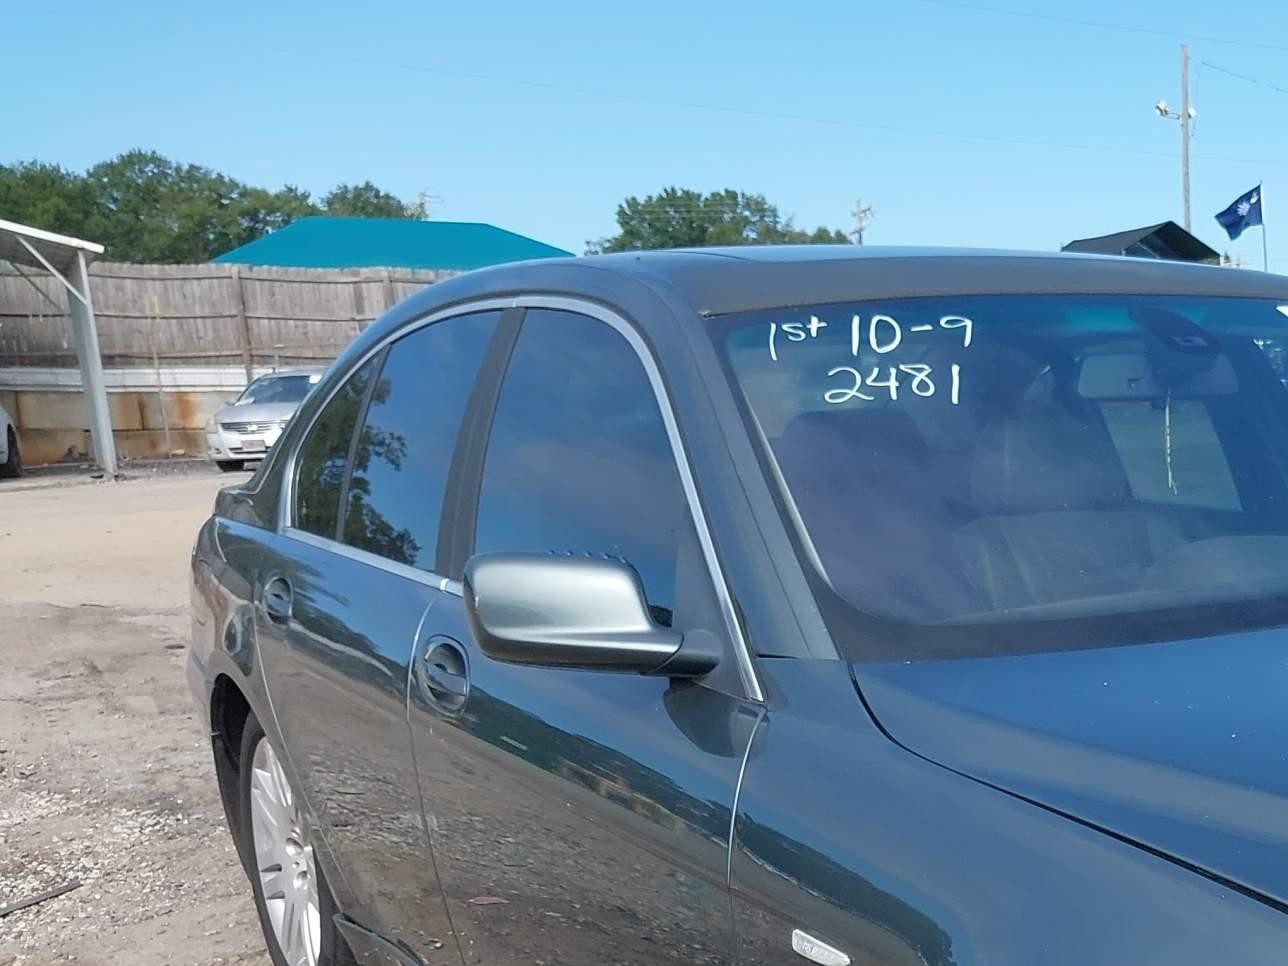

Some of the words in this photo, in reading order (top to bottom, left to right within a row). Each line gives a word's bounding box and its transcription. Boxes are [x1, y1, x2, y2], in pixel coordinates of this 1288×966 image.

[769, 316, 828, 360] 1st
[851, 314, 973, 356] 10-9
[823, 363, 960, 405] 2481
